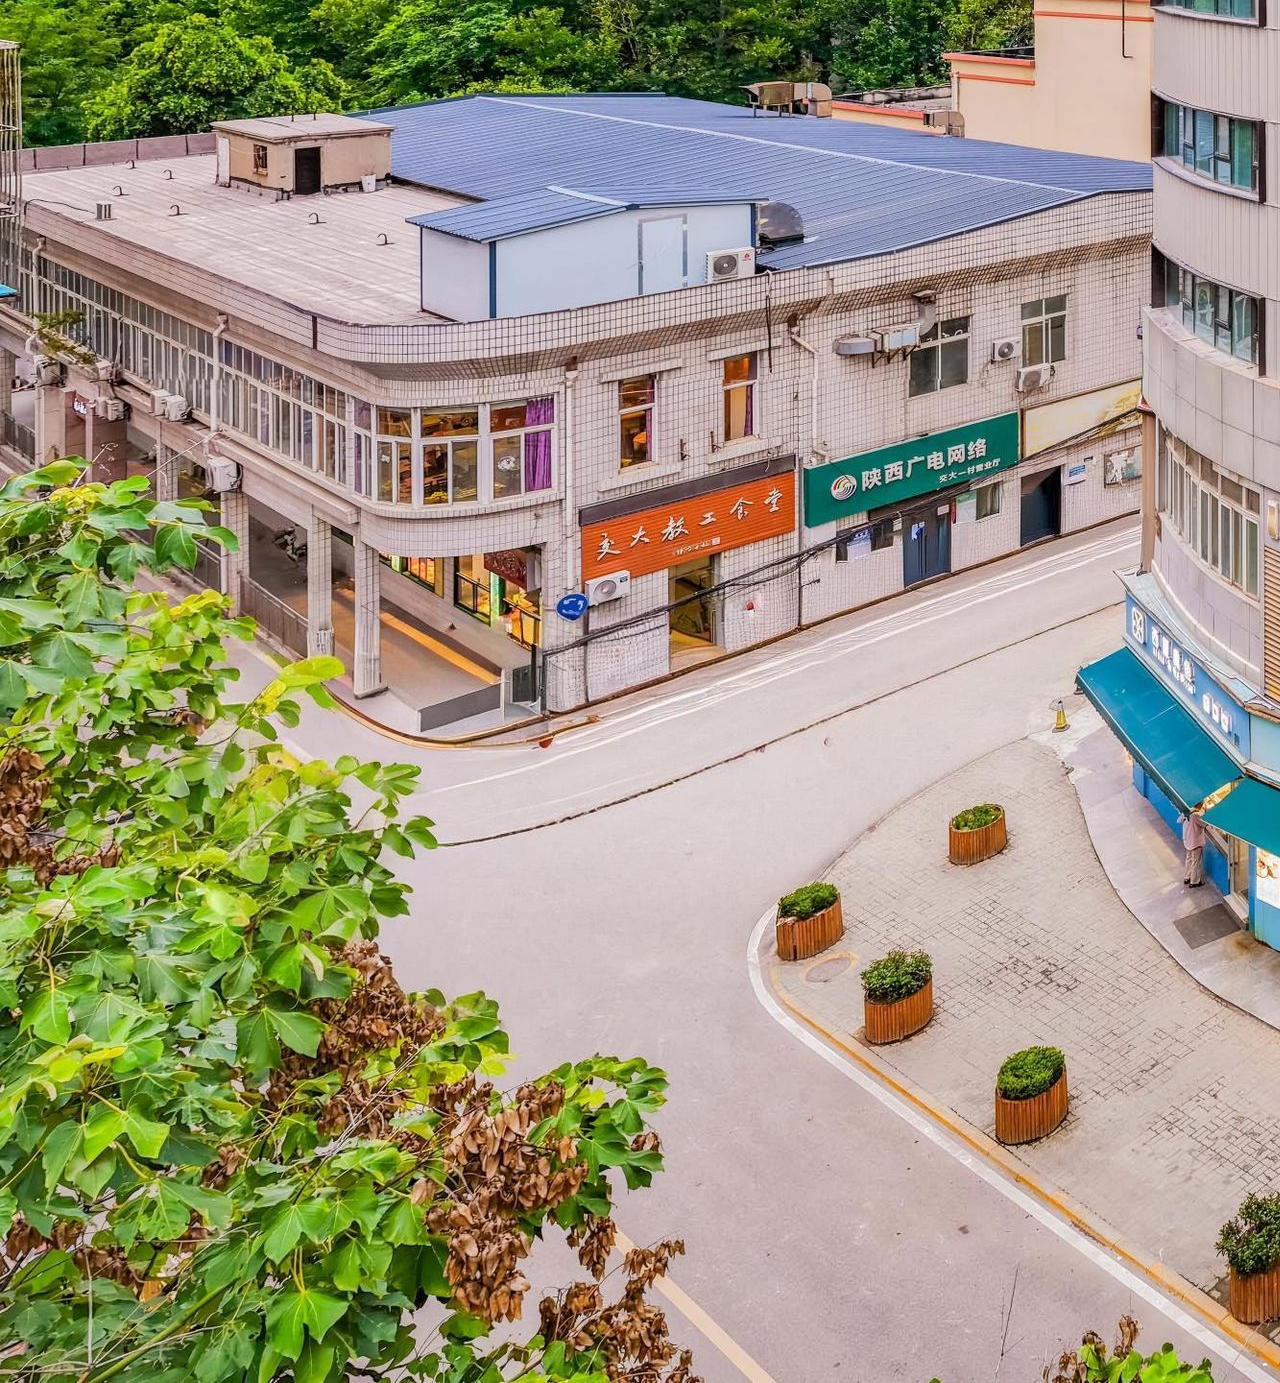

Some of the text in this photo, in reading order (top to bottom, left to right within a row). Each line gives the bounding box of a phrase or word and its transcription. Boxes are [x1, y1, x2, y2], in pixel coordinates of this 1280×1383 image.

[861, 438, 987, 491] 陕西广电网络
[596, 487, 783, 561] 交大教工食堂
